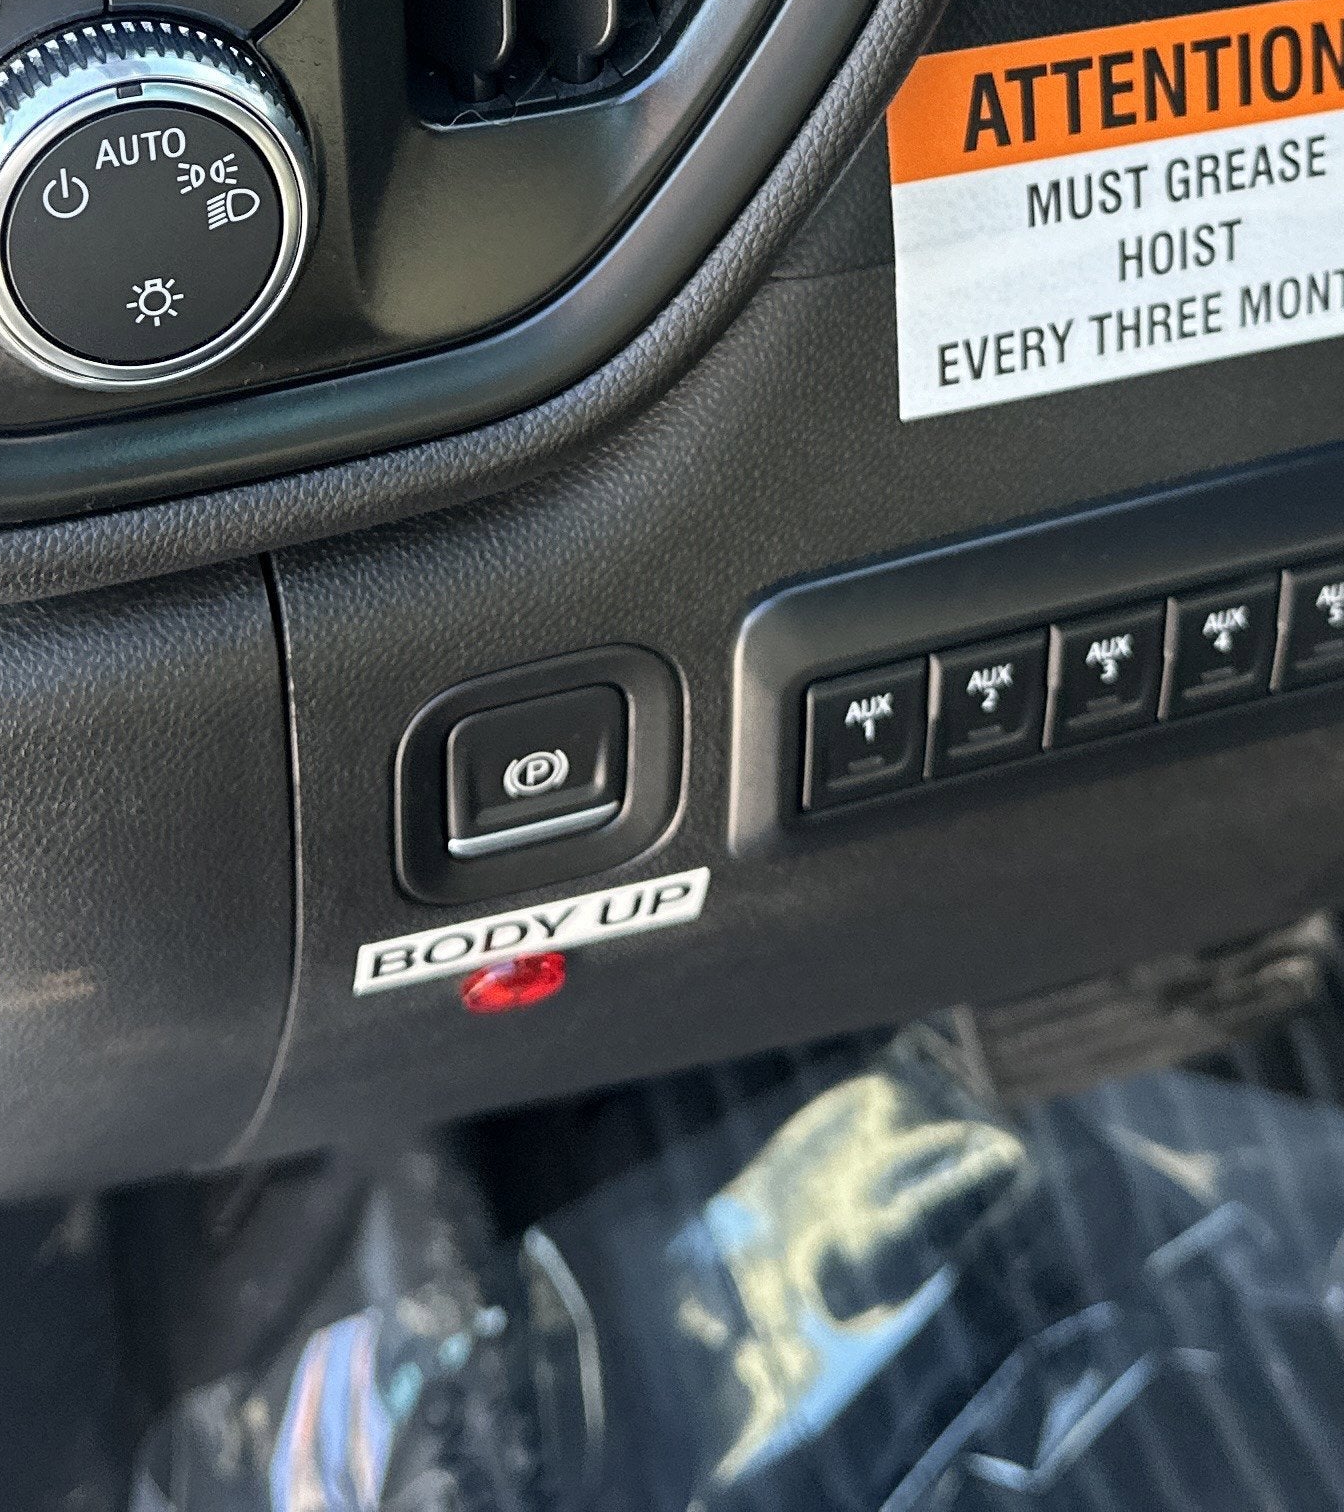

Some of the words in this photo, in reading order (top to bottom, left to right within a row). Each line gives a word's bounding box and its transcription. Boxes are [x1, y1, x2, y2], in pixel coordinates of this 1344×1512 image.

[95, 128, 187, 170] AUTO
[1027, 166, 1149, 227] MUST
[1164, 135, 1327, 202] GREASE
[1118, 220, 1243, 282] HOIST
[938, 321, 1075, 387] EVERY
[1089, 291, 1223, 356] THREE
[1202, 605, 1250, 635] AUX
[1085, 633, 1133, 665] AUX
[1214, 629, 1232, 653] 4
[966, 663, 1014, 694] AUX
[1101, 659, 1117, 683] 3
[845, 692, 893, 725] AUX
[982, 688, 998, 712] 2
[863, 718, 875, 742] 1
[371, 905, 573, 978] BODY
[599, 882, 690, 926] UP
